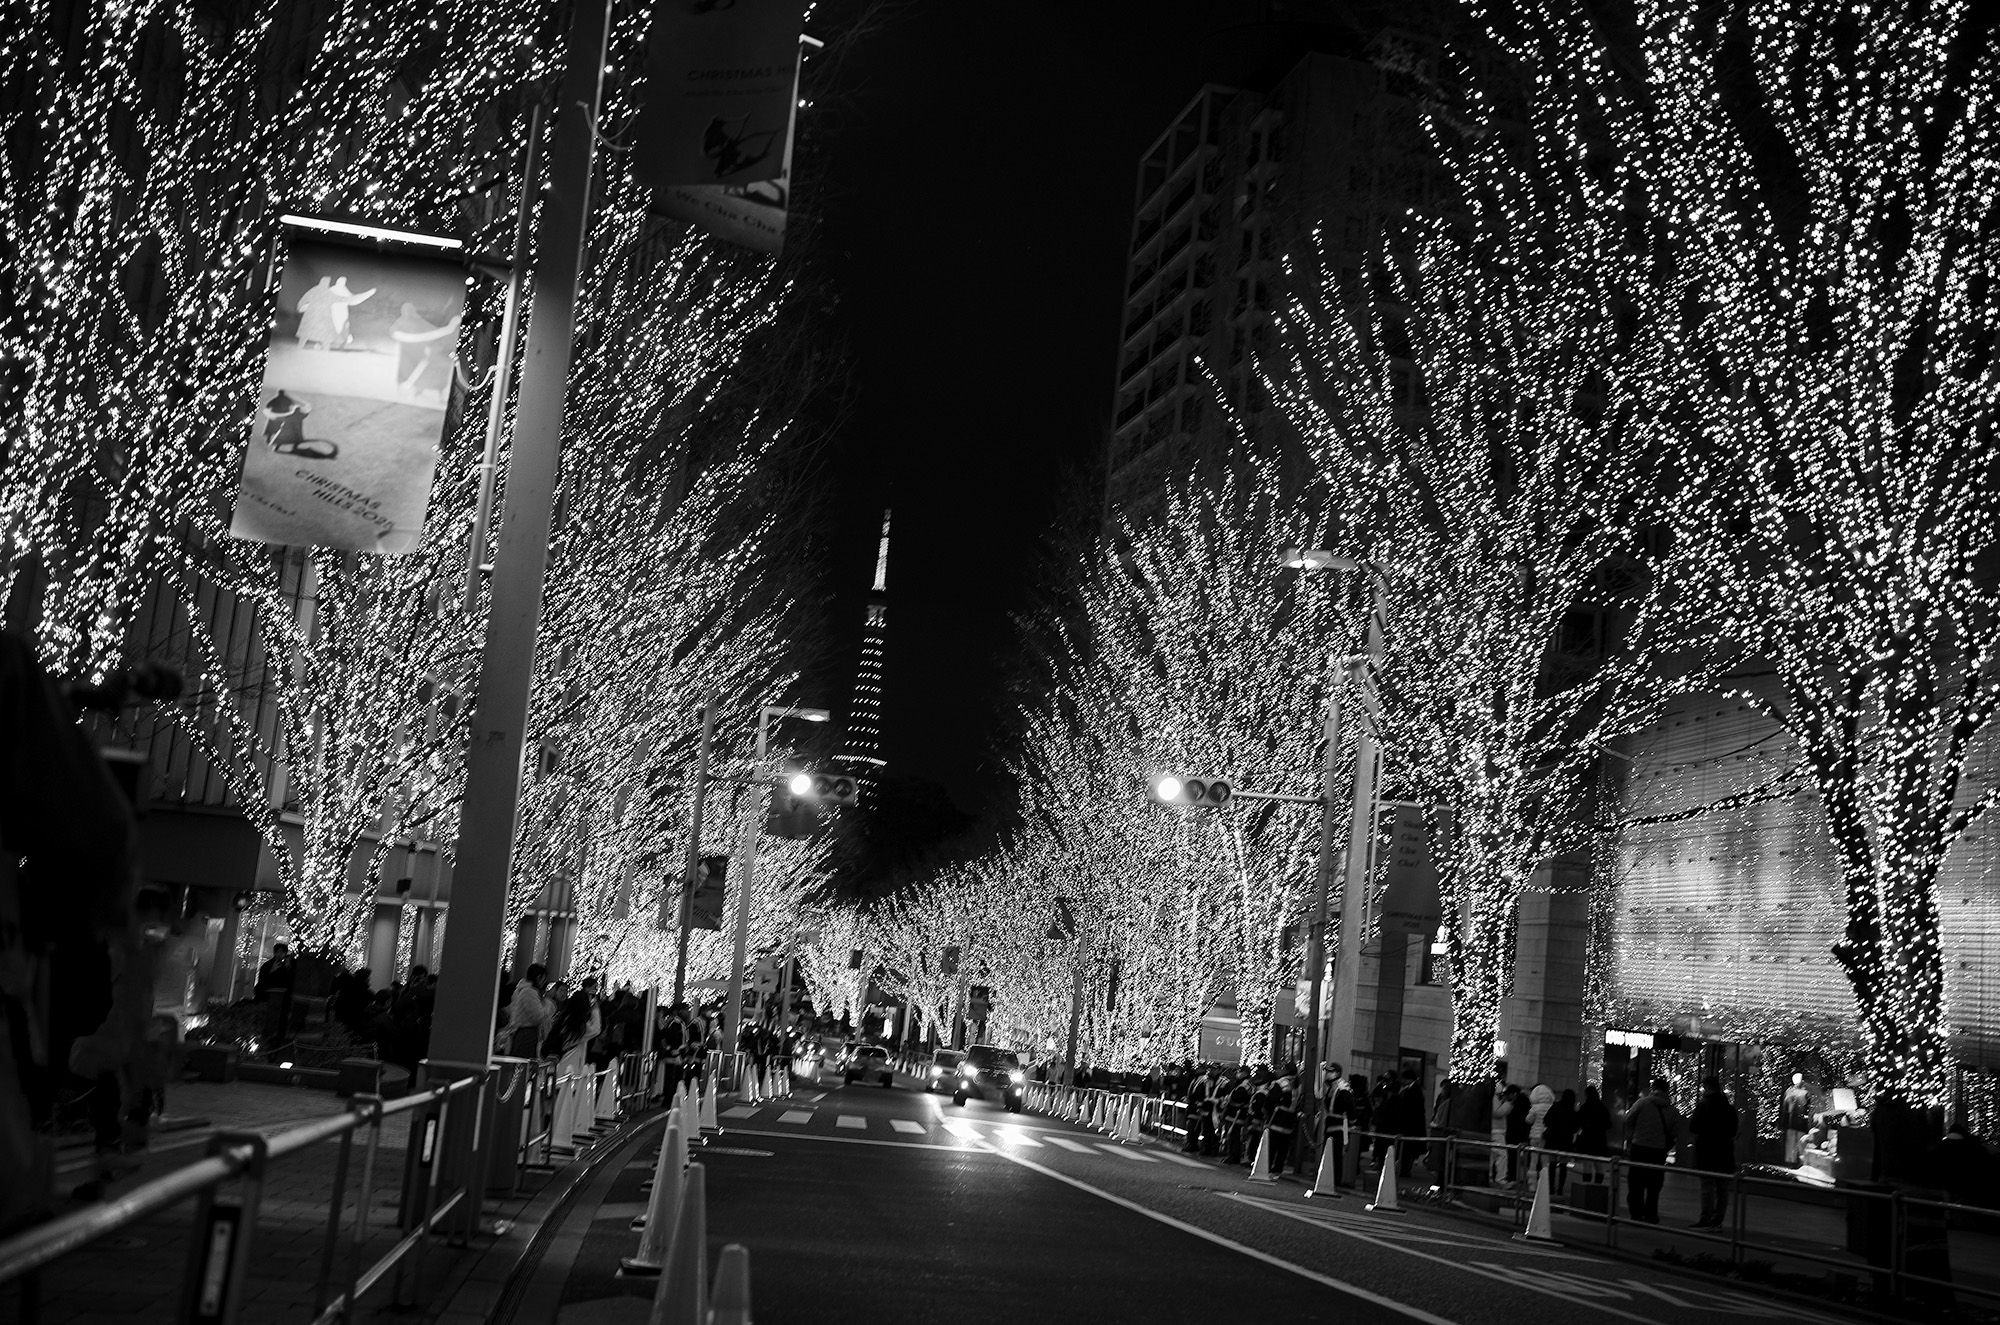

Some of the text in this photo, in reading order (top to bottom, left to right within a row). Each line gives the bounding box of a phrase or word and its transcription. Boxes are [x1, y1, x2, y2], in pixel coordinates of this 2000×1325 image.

[686, 67, 773, 81] CHRISTMAS
[295, 469, 382, 510] CHRISTMAS
[311, 489, 354, 511] HILLS
